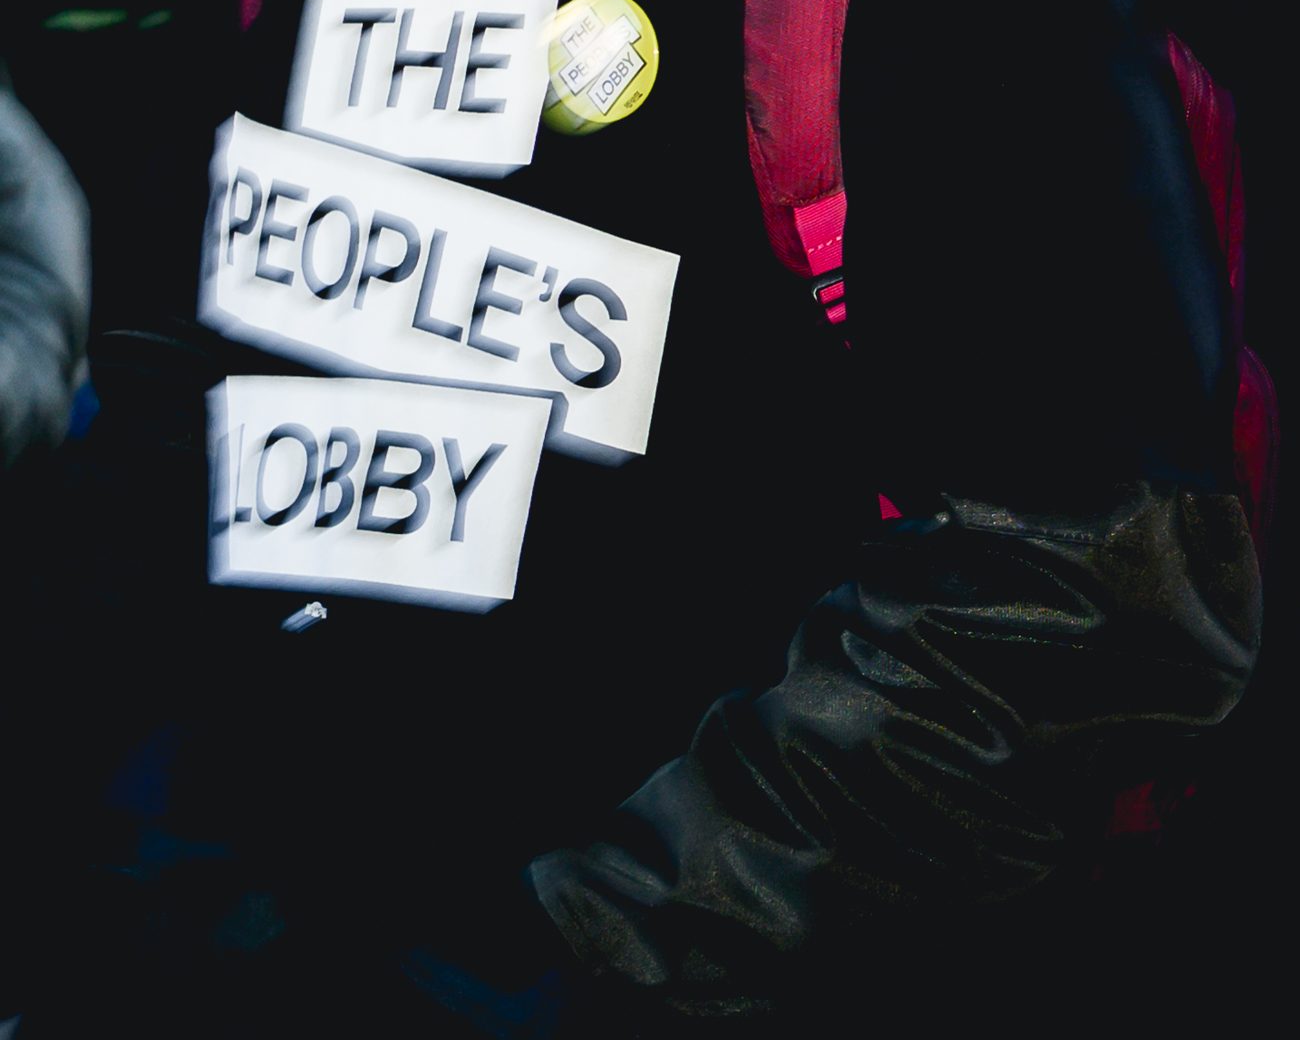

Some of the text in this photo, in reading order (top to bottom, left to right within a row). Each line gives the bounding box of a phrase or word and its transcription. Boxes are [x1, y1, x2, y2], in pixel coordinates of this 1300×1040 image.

[343, 6, 526, 114] THE
[567, 15, 597, 49] THE
[595, 51, 635, 105] LOBBY
[227, 165, 629, 390] PEOPLE'S
[212, 421, 507, 543] LOBBY
